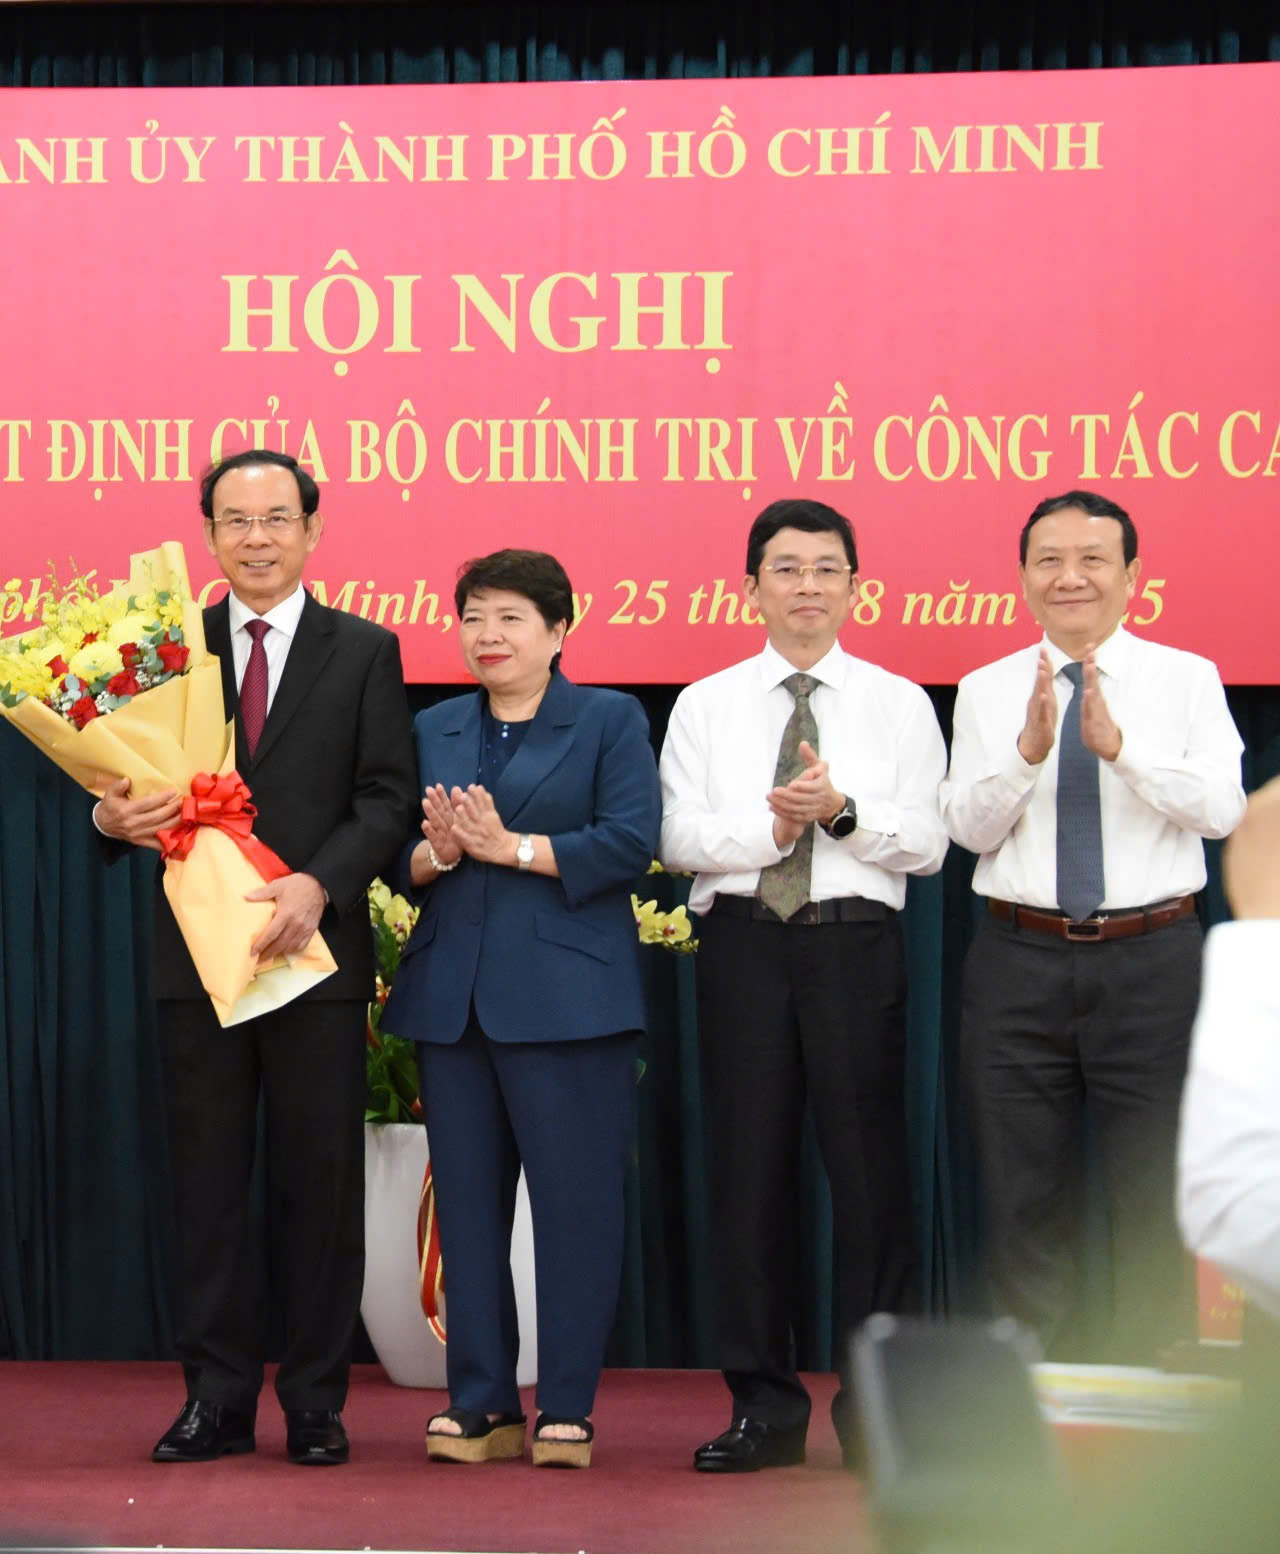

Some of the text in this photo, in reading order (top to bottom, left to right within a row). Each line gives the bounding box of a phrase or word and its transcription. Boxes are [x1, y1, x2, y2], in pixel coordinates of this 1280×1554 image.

[127, 119, 216, 184] ỦY
[235, 121, 469, 183] THÀNH
[487, 107, 628, 182] PHỐ
[647, 105, 748, 180] HỒ
[767, 111, 892, 178] CHÍ
[911, 121, 1106, 175] MINH
[221, 249, 734, 377] HỘI NGHỊ
[47, 418, 193, 501] ĐỊNH
[210, 395, 329, 482] CỦA
[346, 398, 428, 502] BỘ
[445, 397, 639, 484] CHÍNH
[655, 417, 758, 501] TRỊ
[775, 381, 856, 482] VỀ
[873, 395, 1053, 482] CÔNG
[1070, 391, 1199, 480] TÁC
[310, 579, 453, 633] Minh,
[608, 579, 669, 625] 25
[852, 579, 885, 625] 8
[901, 579, 1017, 625] năm
